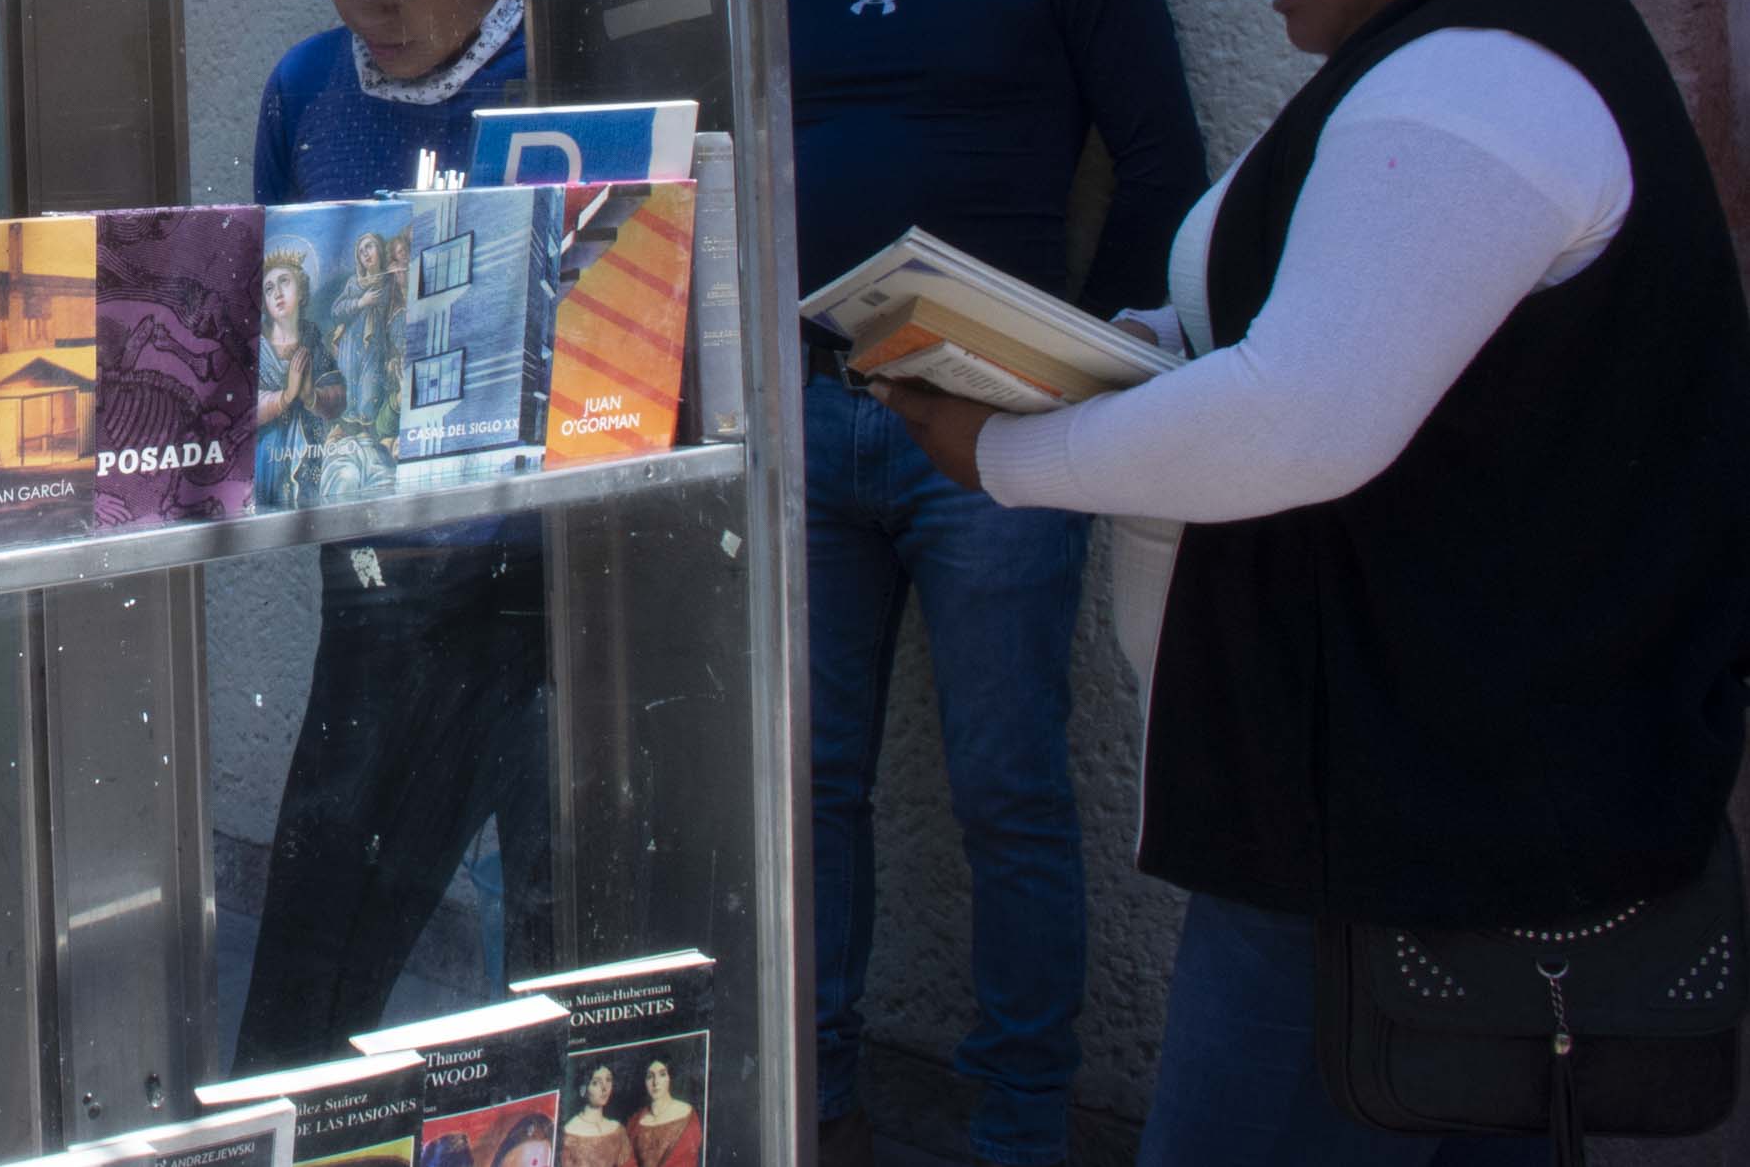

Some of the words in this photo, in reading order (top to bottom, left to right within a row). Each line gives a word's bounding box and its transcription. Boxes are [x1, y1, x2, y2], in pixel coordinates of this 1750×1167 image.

[583, 395, 621, 417] JUAN
[407, 426, 445, 442] CASAS
[449, 423, 466, 436] DEL
[469, 420, 501, 435] SIGLO
[504, 418, 520, 430] XX
[561, 413, 640, 436] O'GORMAN
[97, 441, 225, 476] POSADA
[18, 480, 75, 502] GARCÍA
[576, 983, 672, 1007] Muñiz-Huberman
[570, 997, 675, 1027] ONFIDENTES
[425, 1047, 484, 1069] Tharoor
[324, 1093, 368, 1112] Suárez
[316, 1118, 344, 1133] LAS
[348, 1097, 417, 1127] PASIONES
[167, 1141, 256, 1167] ANDRZEJEWSKI
